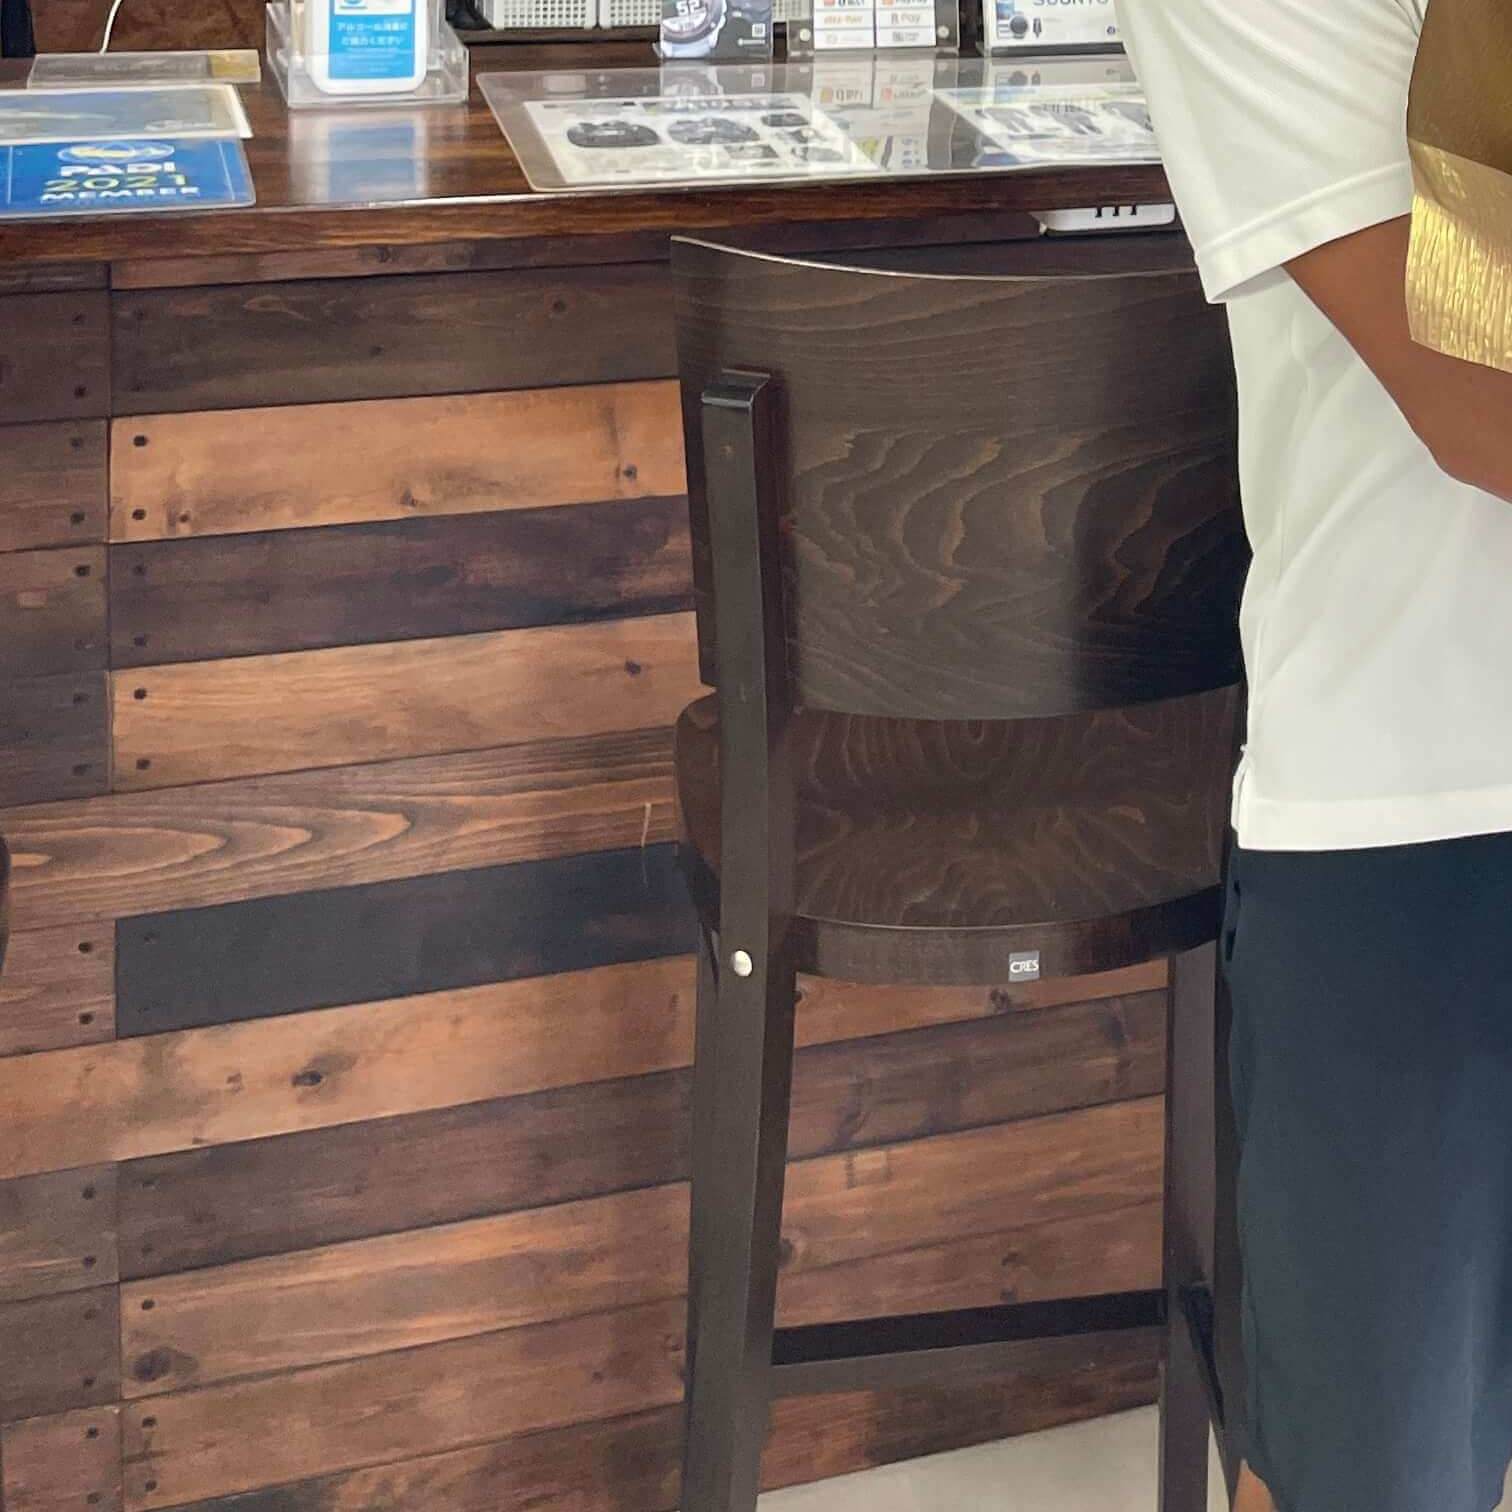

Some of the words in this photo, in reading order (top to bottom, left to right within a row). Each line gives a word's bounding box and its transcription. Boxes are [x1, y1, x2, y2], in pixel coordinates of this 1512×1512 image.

[60, 161, 176, 178] PADI
[45, 174, 187, 193] 2021
[39, 186, 200, 204] MEMBER
